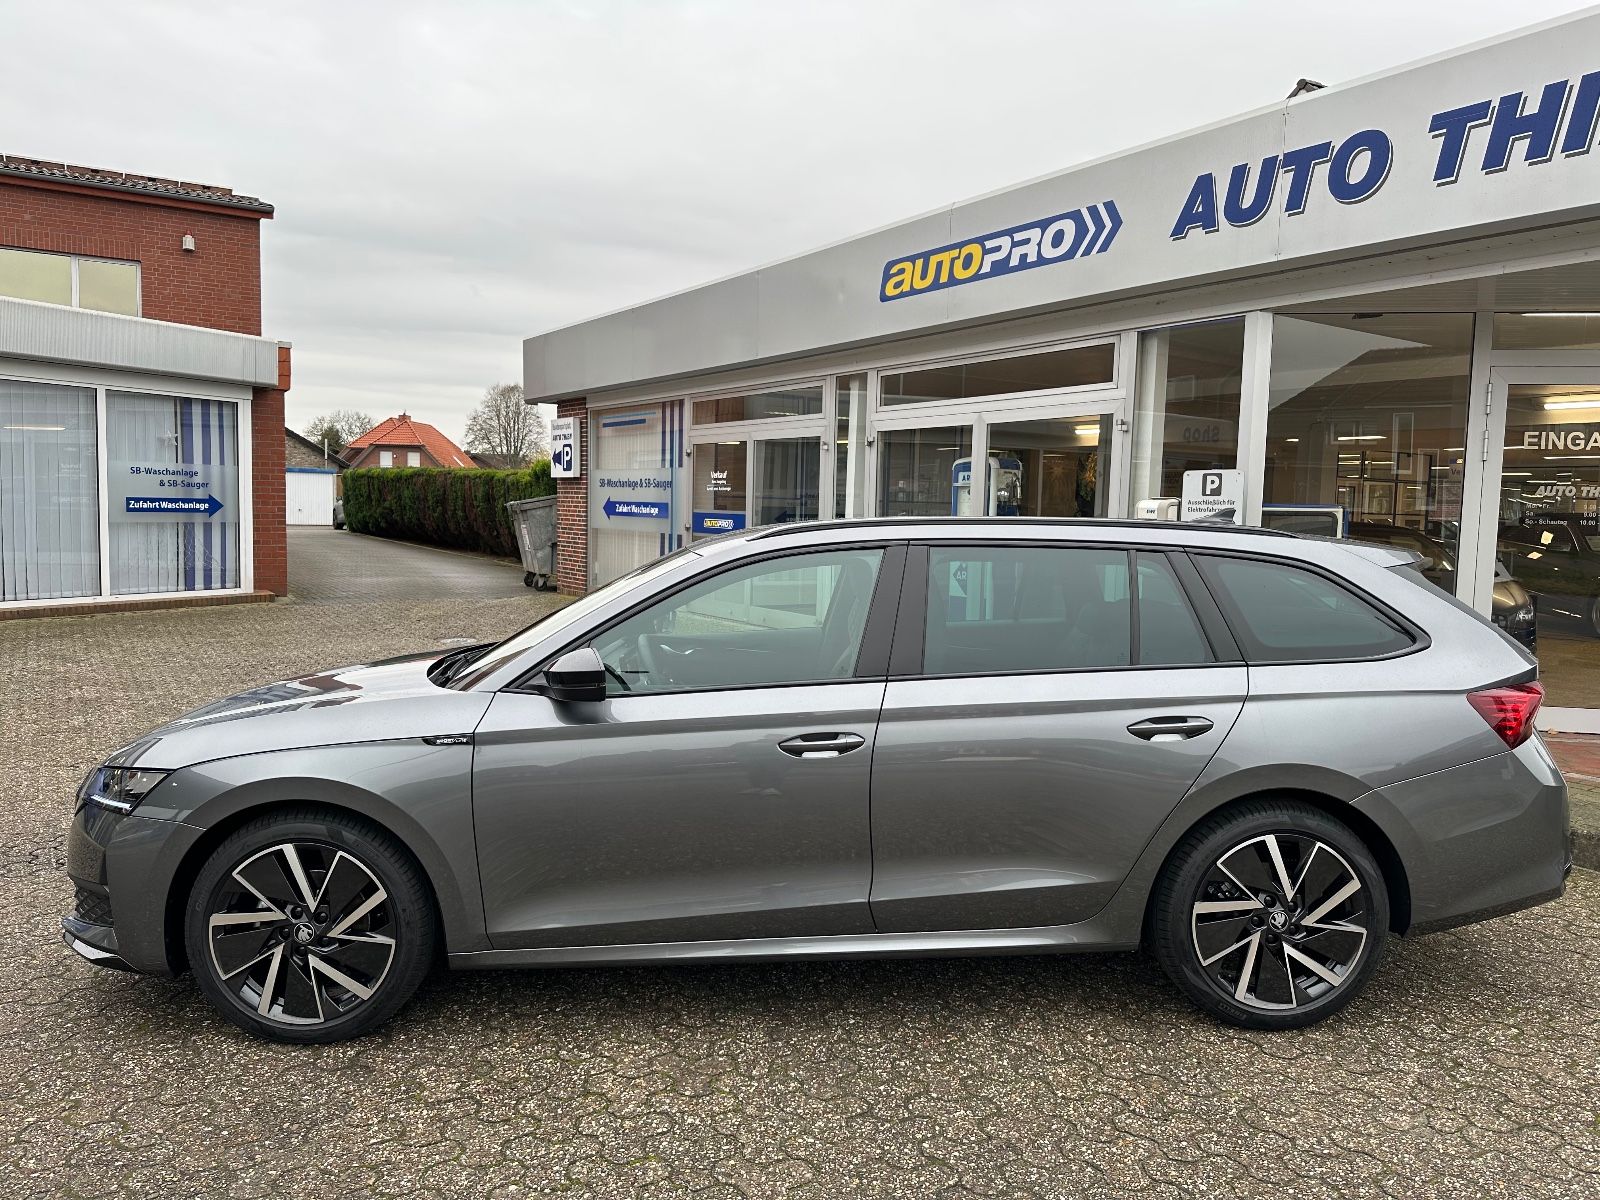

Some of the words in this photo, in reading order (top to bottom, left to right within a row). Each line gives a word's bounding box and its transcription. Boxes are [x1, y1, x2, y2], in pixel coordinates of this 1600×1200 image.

[1169, 129, 1393, 242] AUTO
[130, 466, 199, 478] SB-Waschanlage
[167, 480, 209, 489] SB-Sauger
[599, 478, 638, 490] SB-Waschanlage
[1534, 485, 1576, 497] AUTO
[129, 501, 159, 509] Zufahrt
[160, 501, 209, 511] Waschanlage
[615, 504, 631, 513] Zufahrt
[631, 505, 659, 515] Waschanlage
